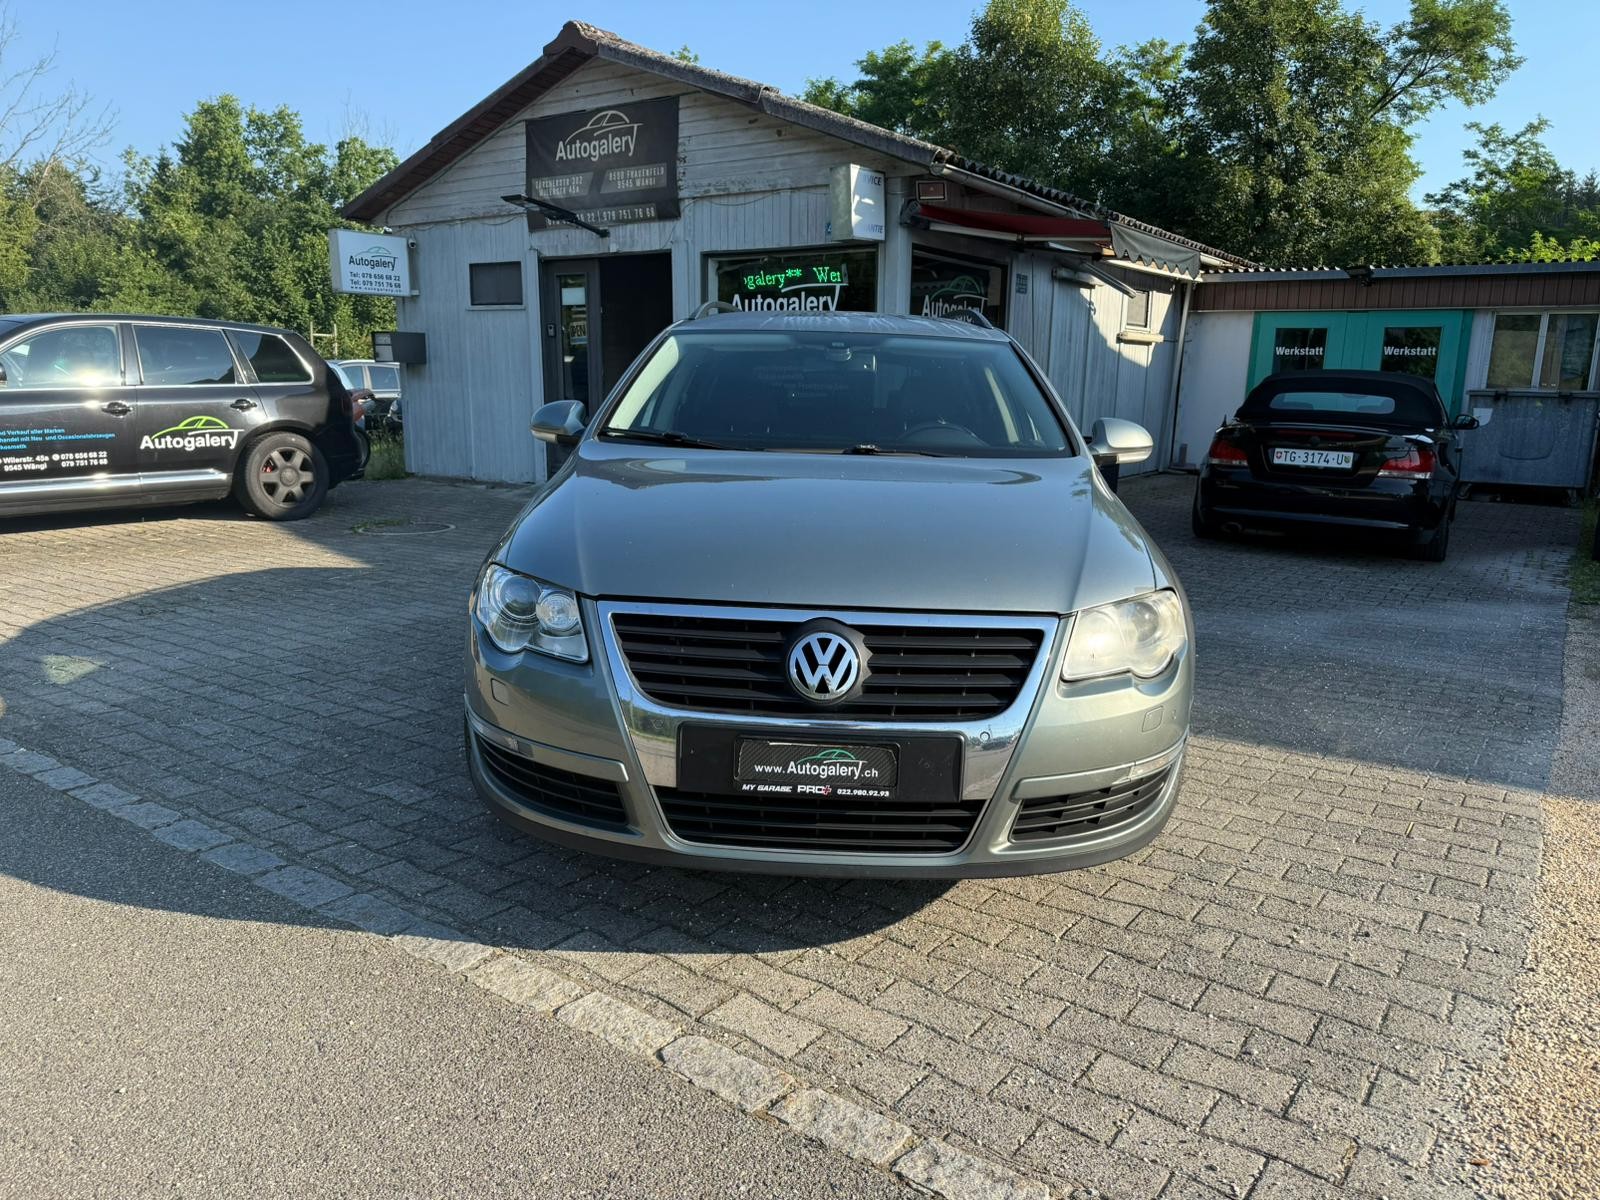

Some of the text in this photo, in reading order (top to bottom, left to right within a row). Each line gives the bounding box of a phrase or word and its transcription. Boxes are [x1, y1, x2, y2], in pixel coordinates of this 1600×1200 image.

[555, 124, 642, 162] Autogalery
[349, 255, 398, 271] Autogalery
[1275, 346, 1324, 356] Werkstatt
[1384, 346, 1437, 356] Werkstatt
[140, 430, 242, 451] Autogalery
[4, 464, 22, 472] 9545
